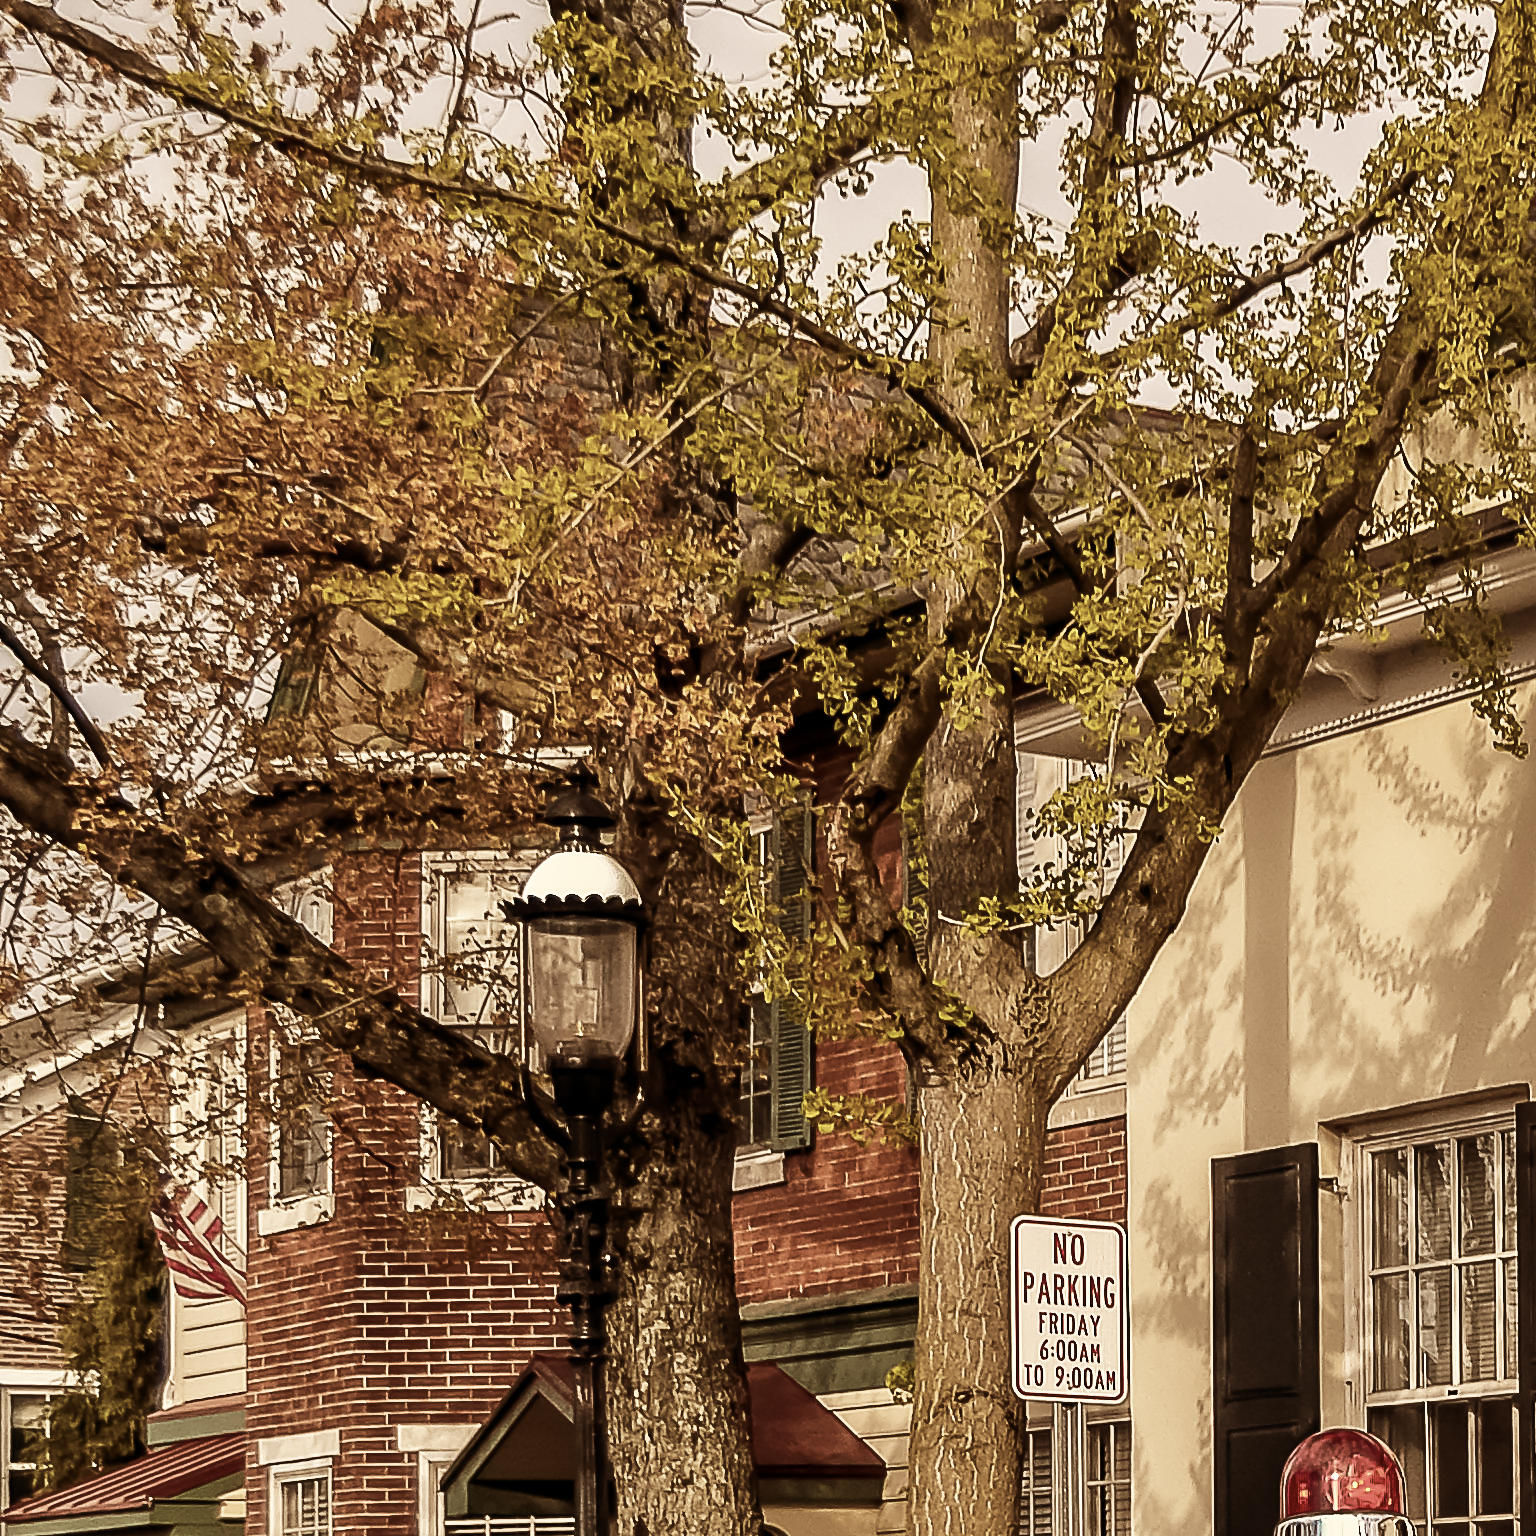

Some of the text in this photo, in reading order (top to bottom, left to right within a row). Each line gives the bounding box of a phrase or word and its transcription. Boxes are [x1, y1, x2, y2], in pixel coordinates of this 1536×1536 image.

[1053, 1231, 1085, 1266] NO
[1022, 1271, 1116, 1309] PARKING
[1038, 1311, 1101, 1337] FRIDAY
[1039, 1338, 1101, 1364] 6:00AM
[1023, 1363, 1116, 1391] TO 9:00AM
